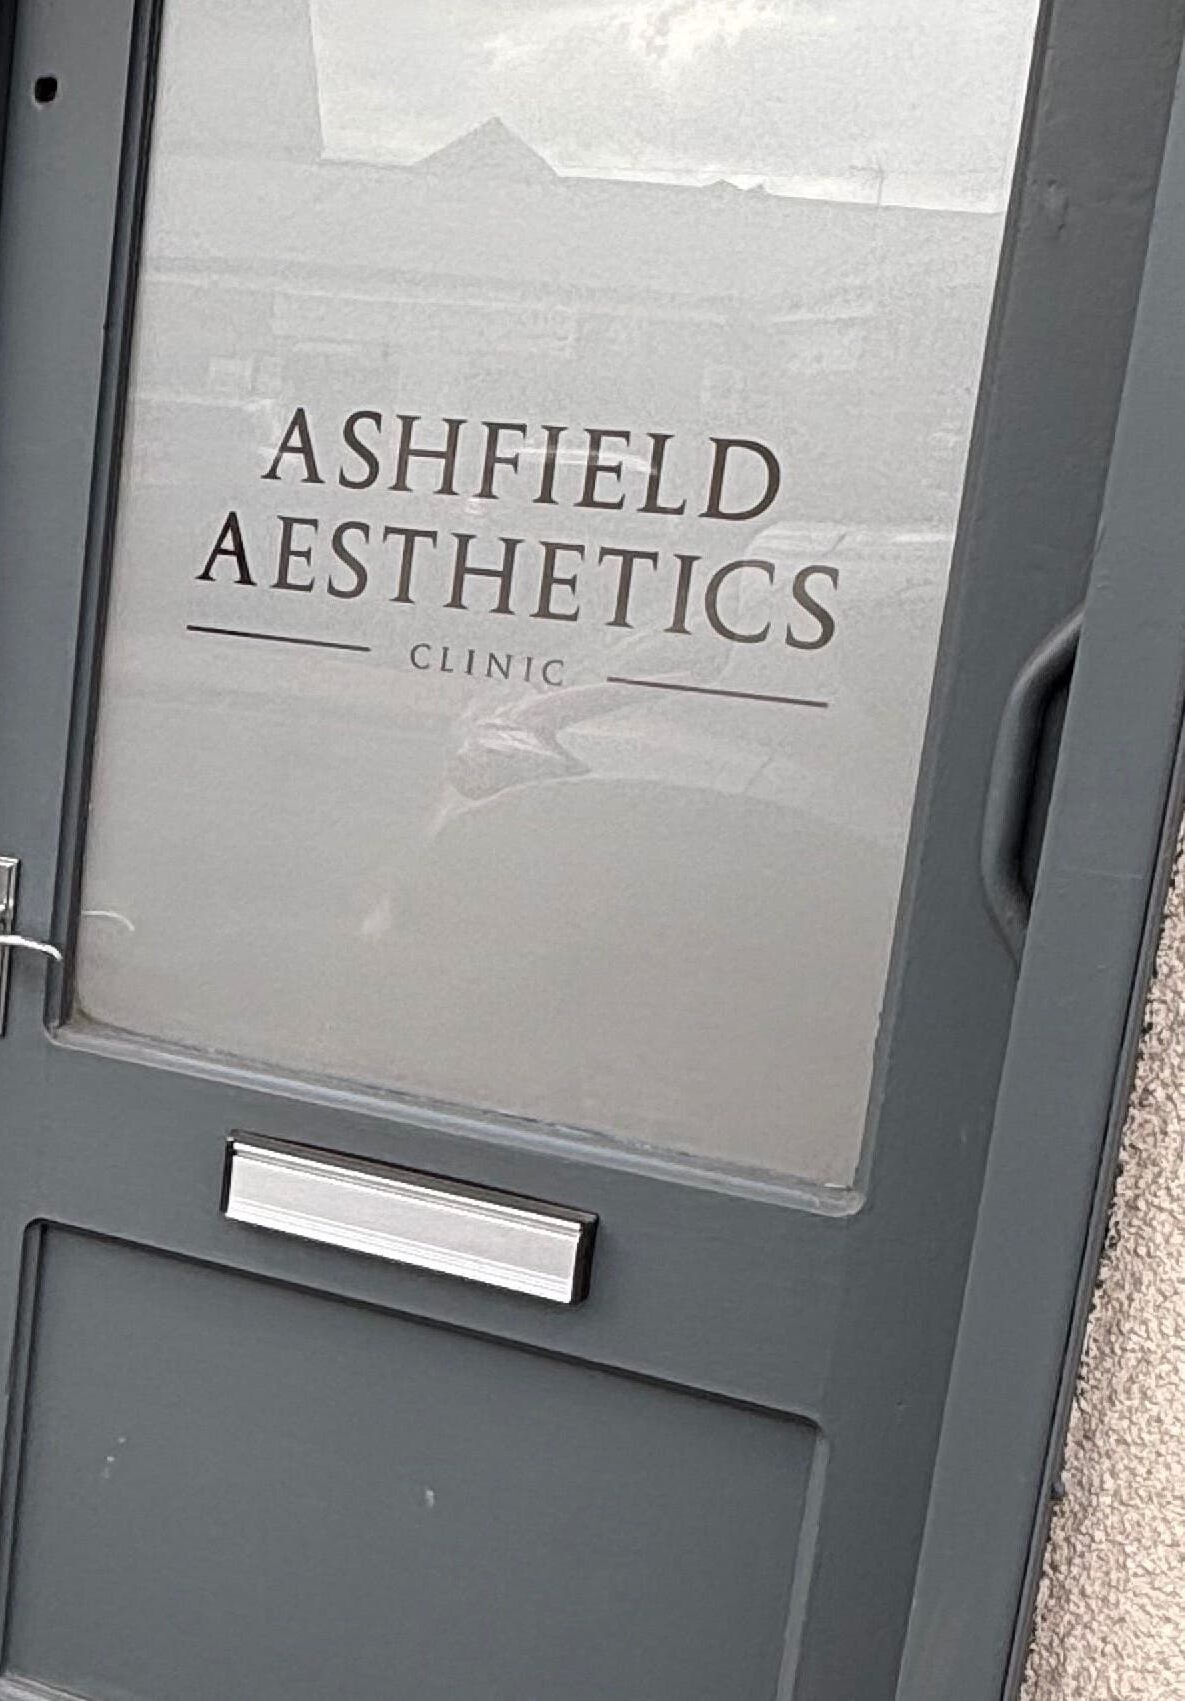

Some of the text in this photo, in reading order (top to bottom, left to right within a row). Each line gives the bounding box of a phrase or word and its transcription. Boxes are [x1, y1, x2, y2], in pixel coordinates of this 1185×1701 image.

[261, 407, 781, 521] ASHFIELD
[195, 510, 840, 650] AESTHETICS
[410, 643, 564, 686] CLINIC
